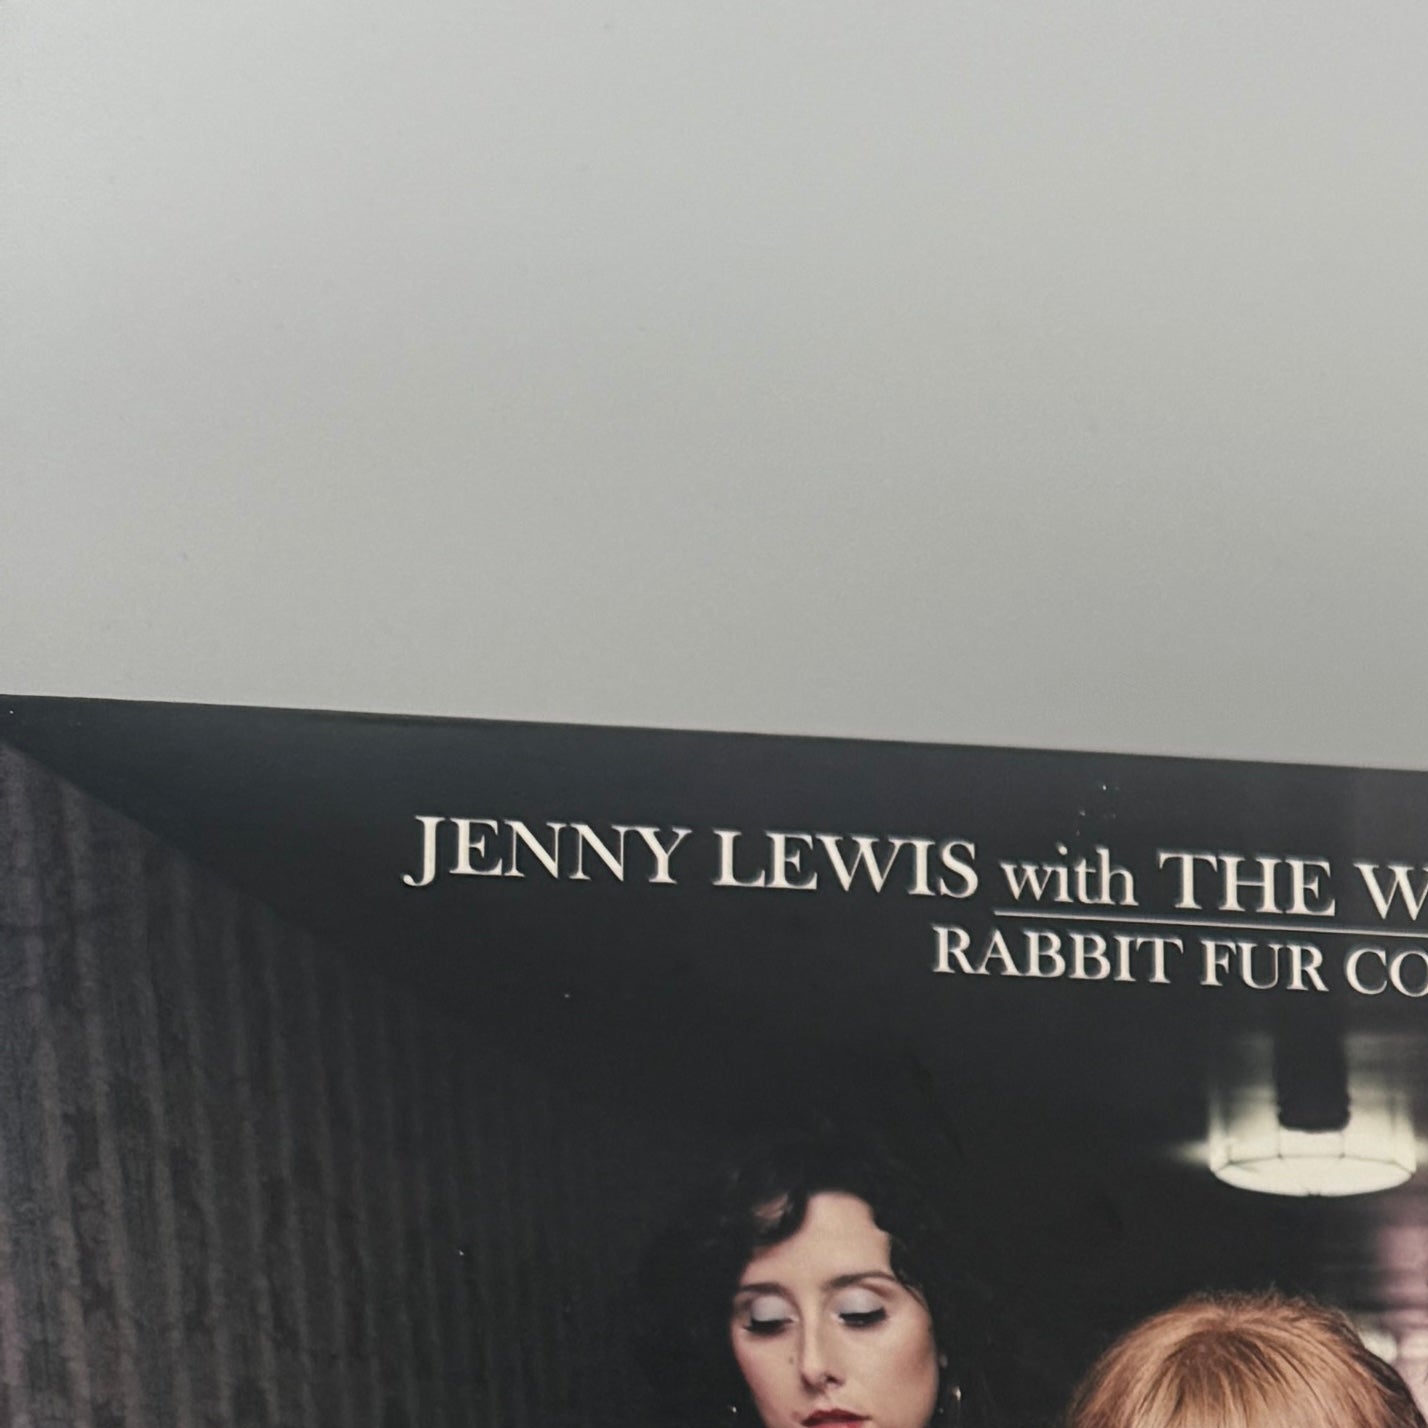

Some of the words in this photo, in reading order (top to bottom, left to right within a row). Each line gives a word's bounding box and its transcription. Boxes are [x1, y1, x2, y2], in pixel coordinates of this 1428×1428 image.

[403, 815, 692, 888] JENNY
[713, 829, 979, 899] LEWIS
[1001, 844, 1139, 910] with
[1157, 852, 1337, 918] THE
[932, 925, 1185, 986] RABBIT
[1200, 939, 1330, 993] FUR
